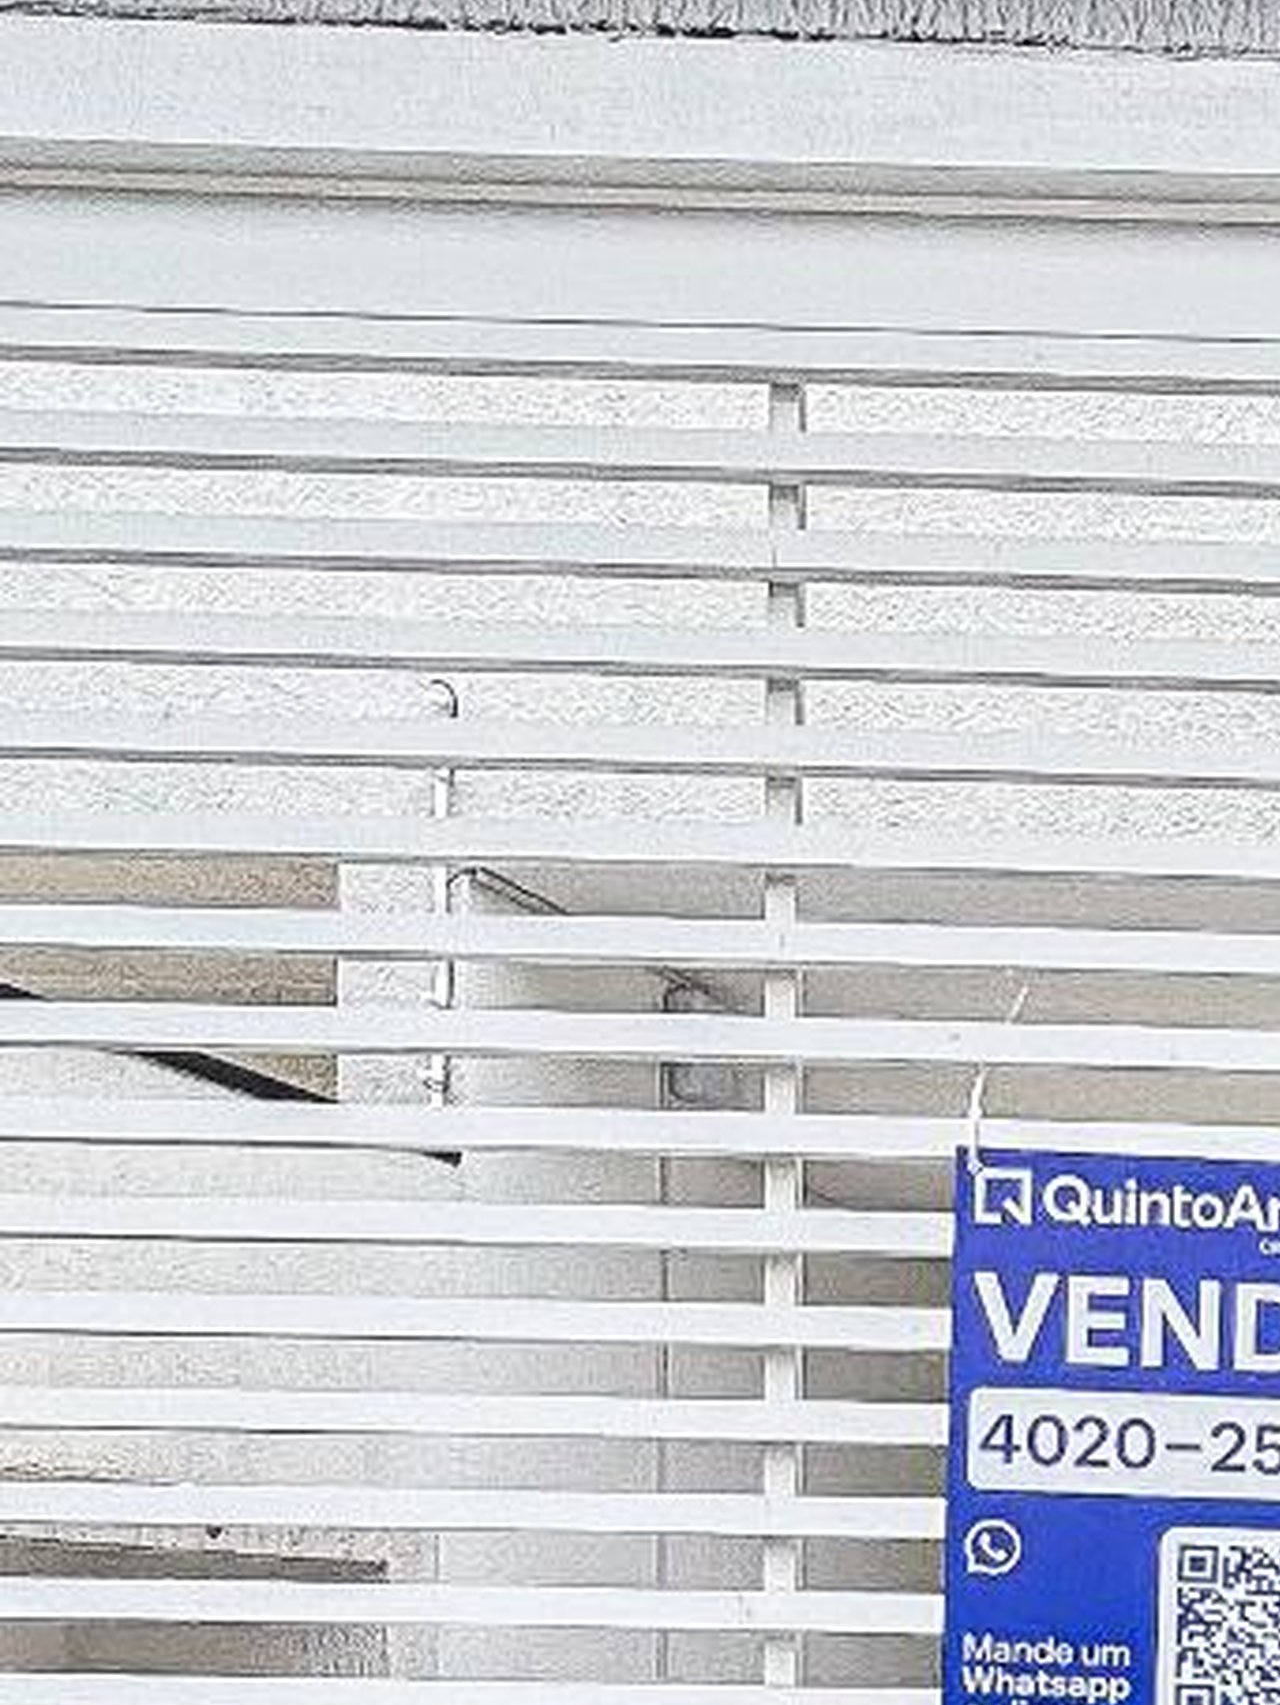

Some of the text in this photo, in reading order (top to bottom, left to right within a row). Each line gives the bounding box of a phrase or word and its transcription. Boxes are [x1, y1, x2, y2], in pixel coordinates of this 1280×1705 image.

[962, 1631, 1131, 1667] Mande um
[962, 1665, 1132, 1705] Whatsapp
